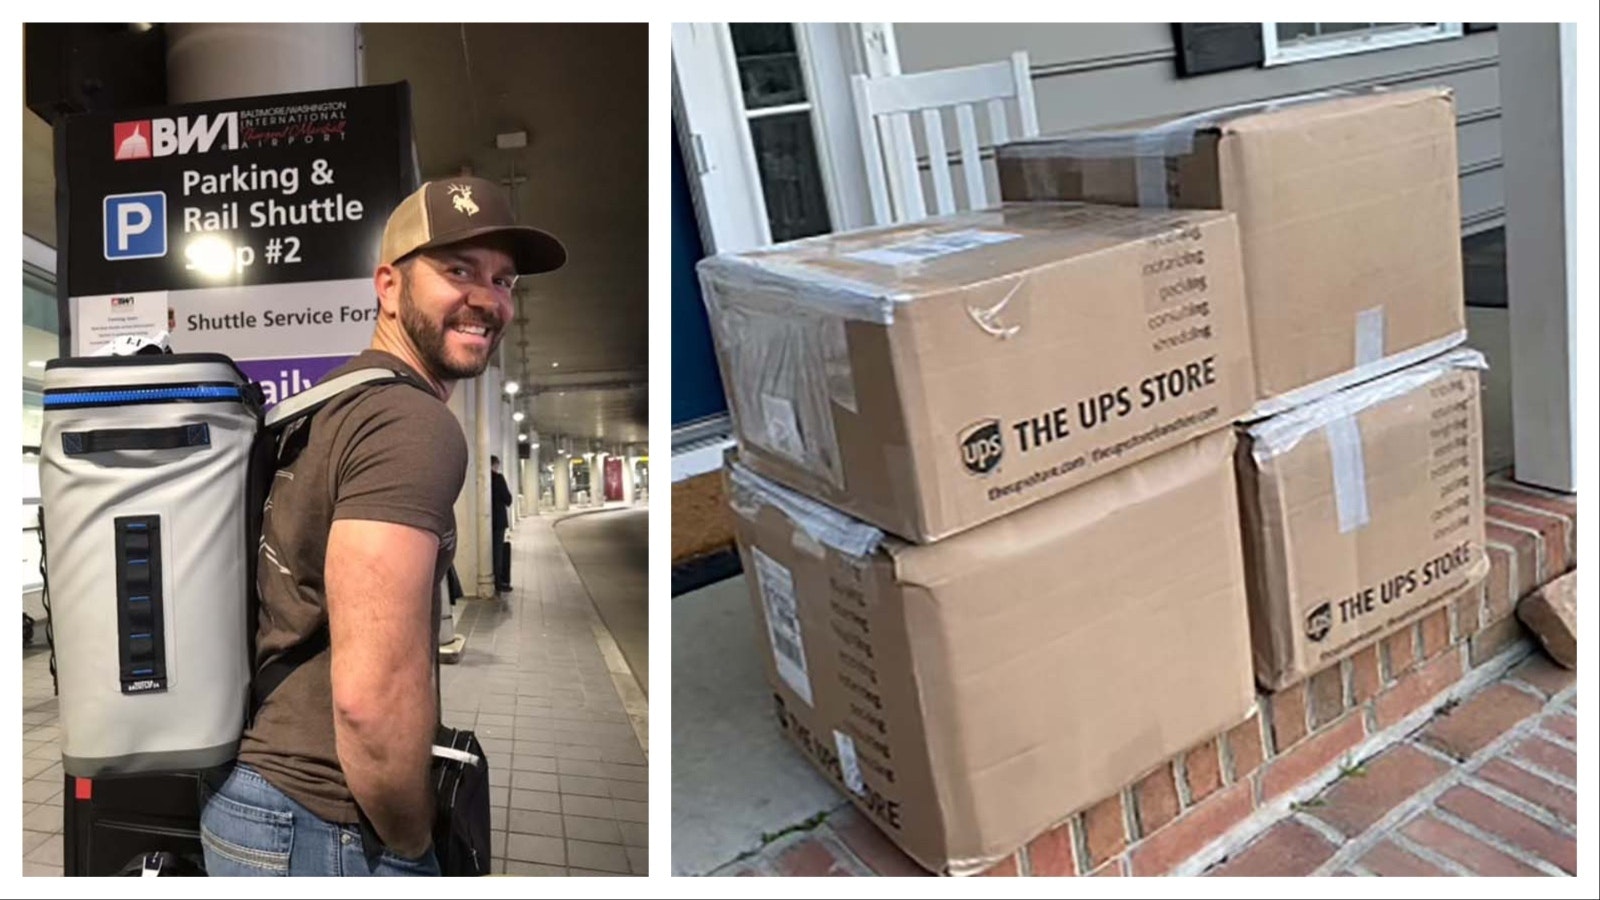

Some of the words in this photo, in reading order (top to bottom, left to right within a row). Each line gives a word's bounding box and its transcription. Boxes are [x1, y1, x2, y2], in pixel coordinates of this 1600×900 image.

[152, 111, 239, 158] BWI
[240, 111, 346, 128] INTERNATIONAL
[240, 132, 346, 149] AIRPORT
[183, 164, 299, 196] Parking
[311, 158, 335, 186] &
[117, 202, 152, 251] P
[184, 202, 239, 233] Rail
[250, 193, 364, 228] Shuttle
[265, 236, 302, 265] #2
[187, 311, 257, 331] Shuttle
[263, 307, 333, 327] Service
[1013, 407, 1070, 453] THE
[1078, 386, 1132, 430] UPS
[1139, 356, 1217, 409] STORE
[1338, 588, 1376, 624] THE
[1380, 569, 1417, 605] UPS
